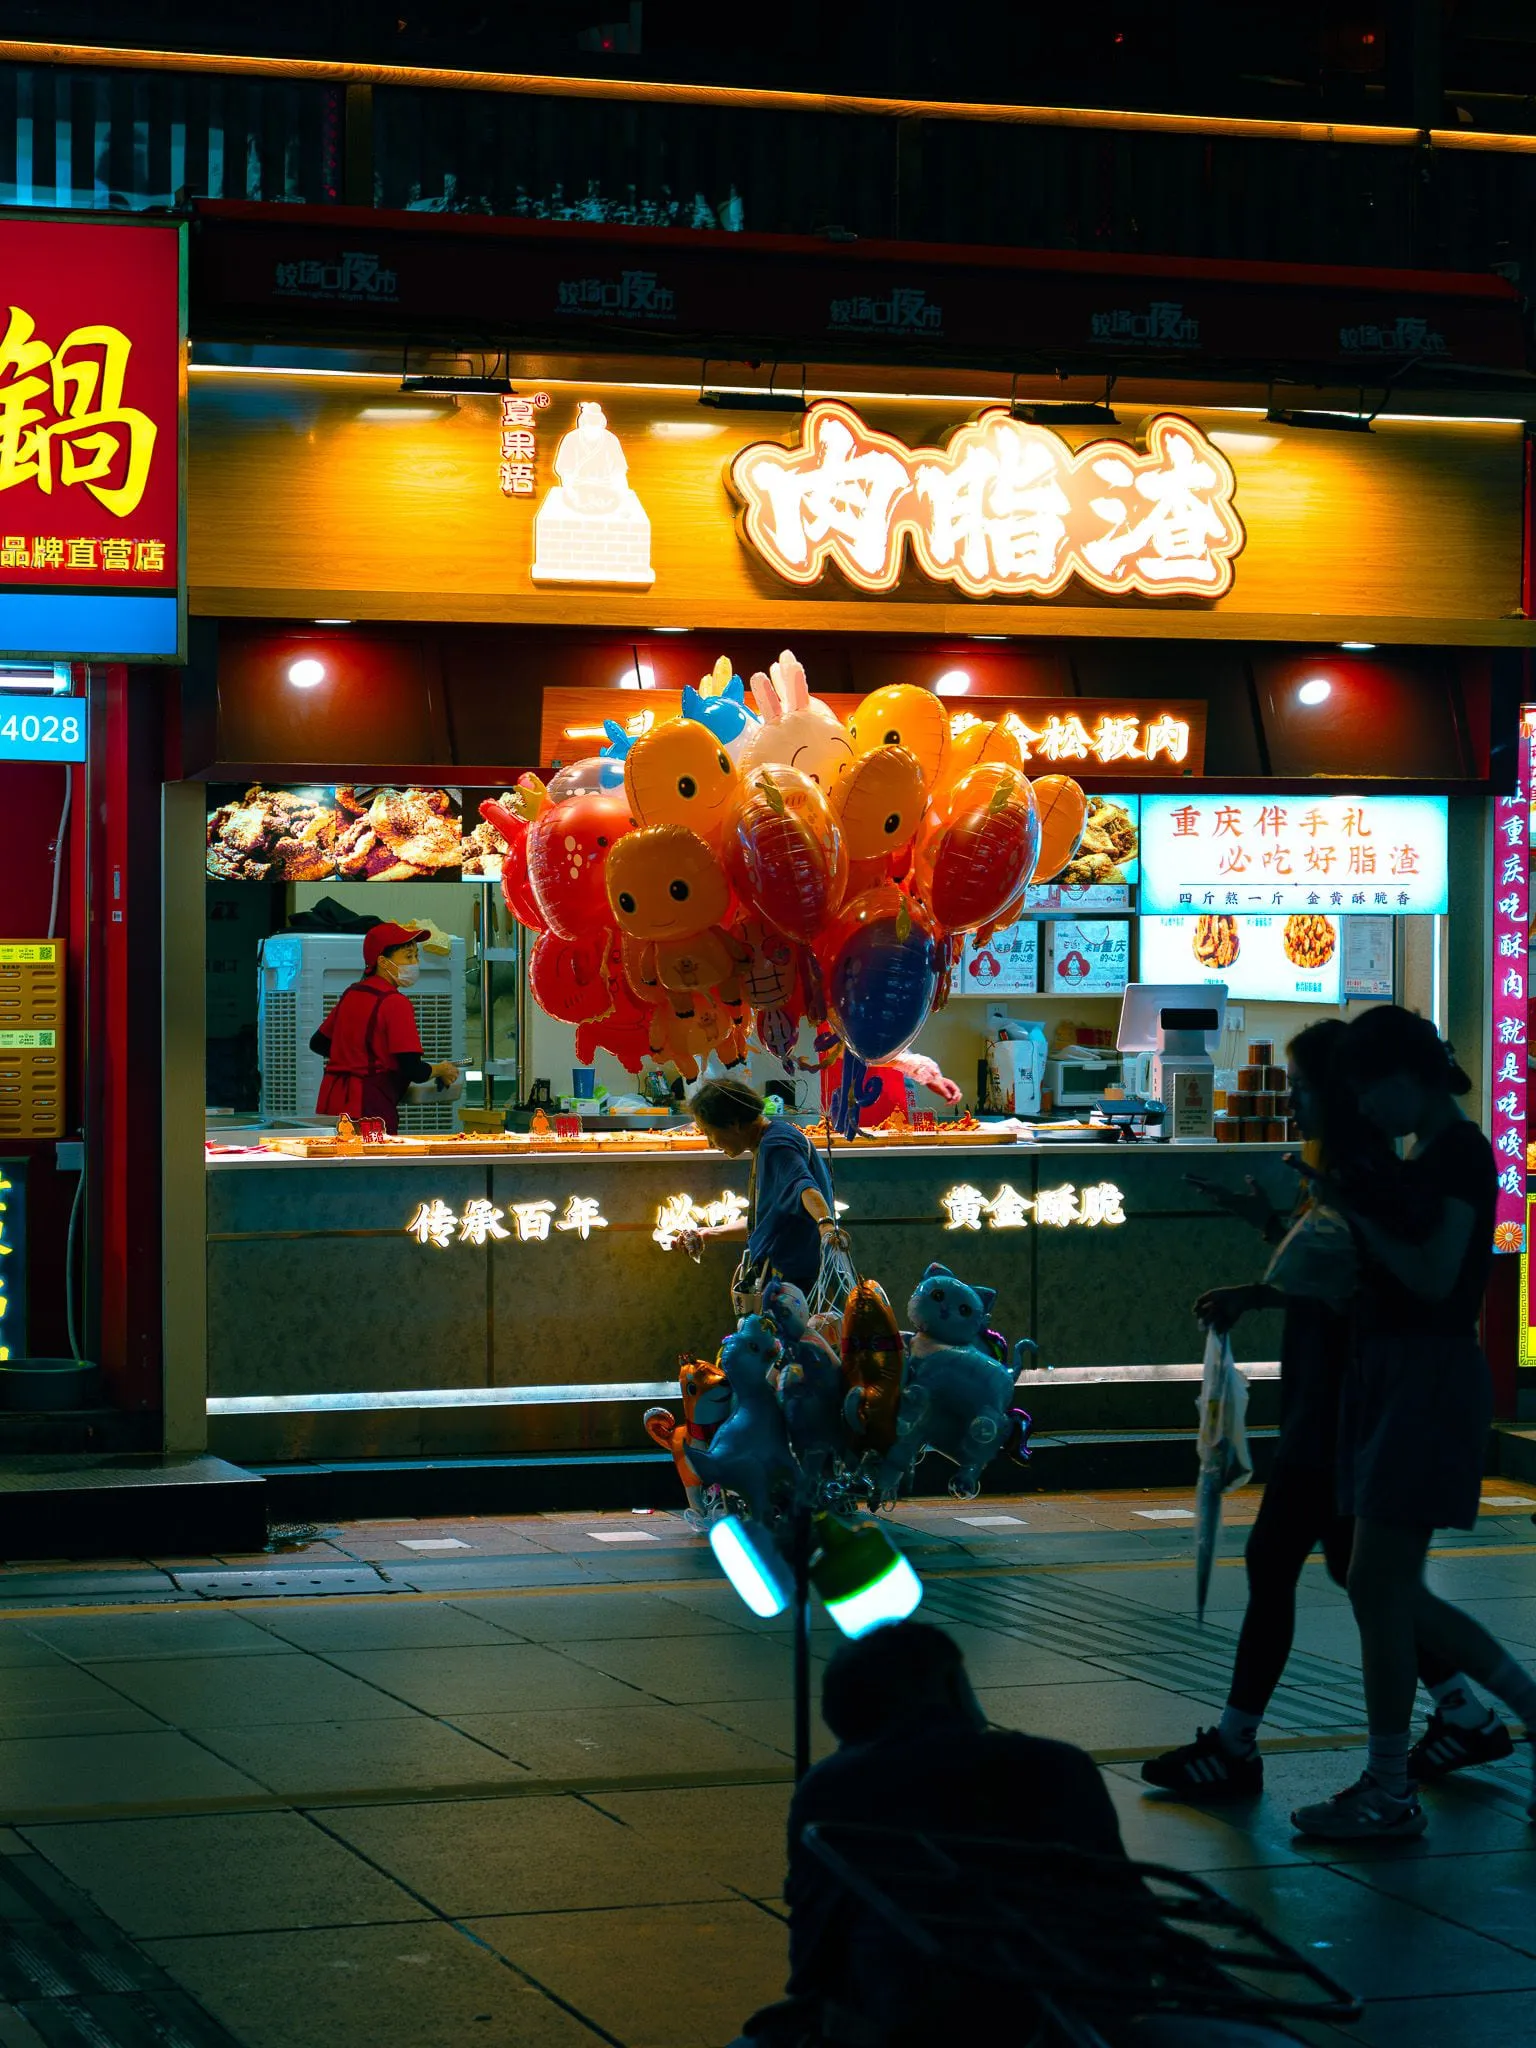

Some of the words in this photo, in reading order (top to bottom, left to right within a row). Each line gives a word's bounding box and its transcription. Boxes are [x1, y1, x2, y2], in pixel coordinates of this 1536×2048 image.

[0, 305, 158, 518] 鍋
[750, 417, 1229, 581] 肉脂渣
[0, 535, 166, 572] 品牌直营店
[0, 714, 80, 744] 4028
[1170, 804, 1373, 838] 重庆伴手礼
[1218, 843, 1421, 876] 必吃好脂渣
[1179, 890, 1285, 906] 四斤熬一斤
[1305, 890, 1412, 906] 金黄酥脆香
[406, 1194, 609, 1248] 传承百年
[941, 1181, 1127, 1231] 黄金酥脆
